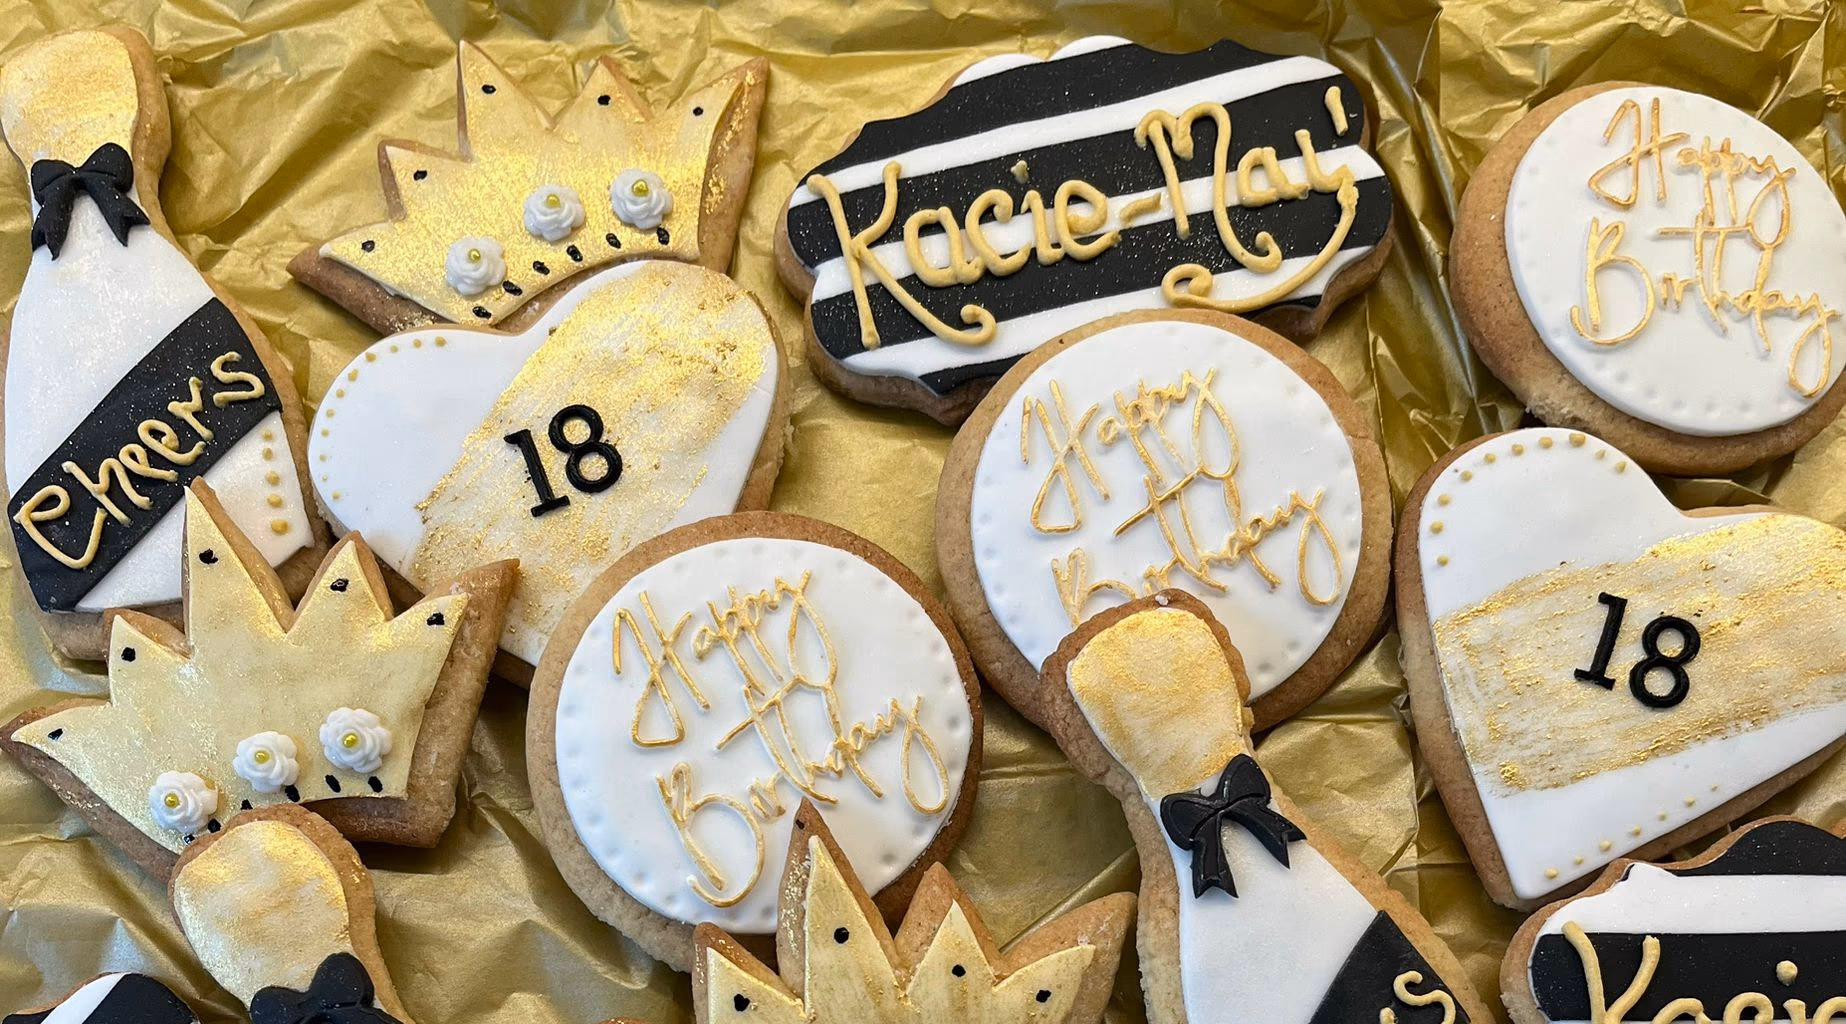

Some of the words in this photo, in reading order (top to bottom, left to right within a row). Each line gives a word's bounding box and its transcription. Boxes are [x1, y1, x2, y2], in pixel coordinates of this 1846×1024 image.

[1587, 96, 1797, 248] Happy
[13, 351, 265, 570] Cheers
[503, 404, 623, 518] 18
[1020, 367, 1240, 534] Happy
[612, 569, 838, 748] Happy
[1574, 591, 1701, 709] 18
